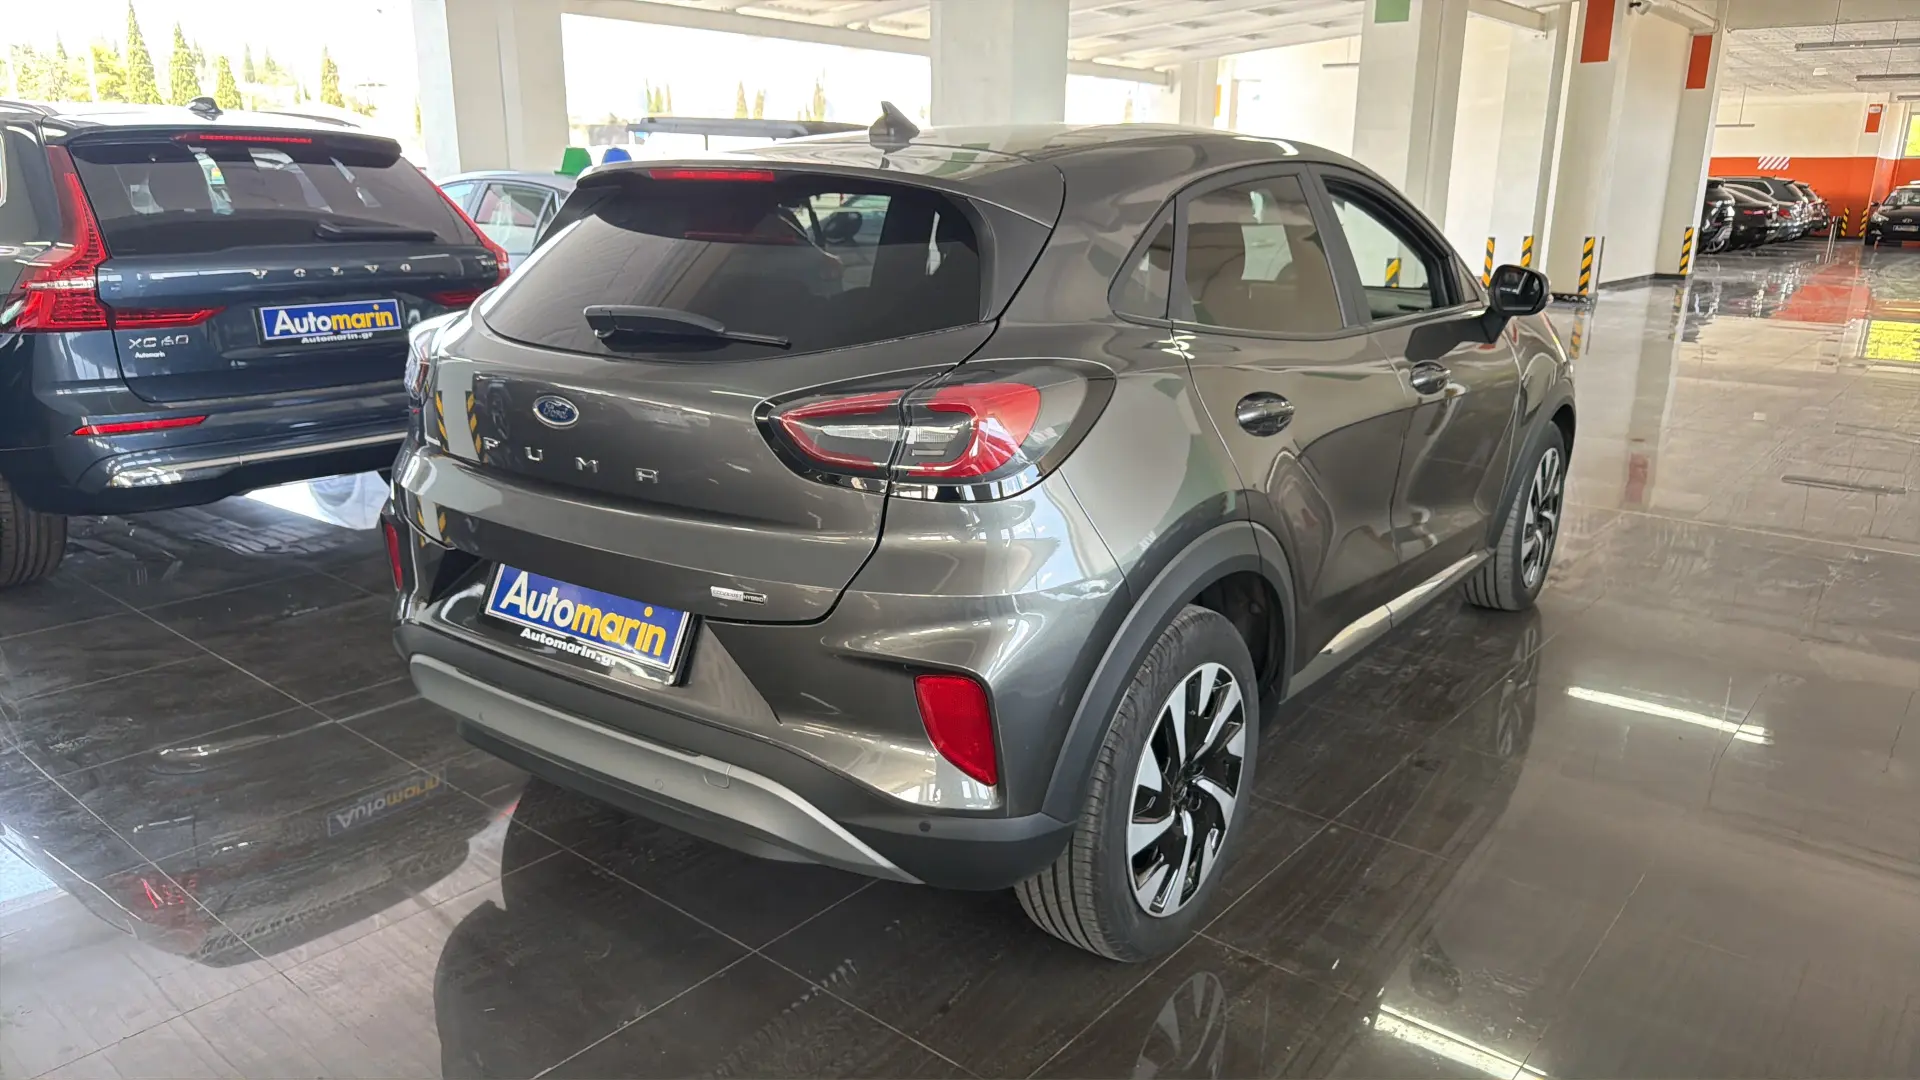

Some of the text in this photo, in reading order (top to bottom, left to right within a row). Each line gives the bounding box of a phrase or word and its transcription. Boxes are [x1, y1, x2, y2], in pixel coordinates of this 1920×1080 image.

[251, 263, 411, 279] VOLVO
[274, 304, 394, 336] Automarin
[129, 335, 189, 349] XC60
[301, 332, 373, 344] Automarin.gr
[483, 436, 659, 484] PUMA
[500, 571, 667, 657] Automarin
[520, 628, 617, 667] Automarin.gr
